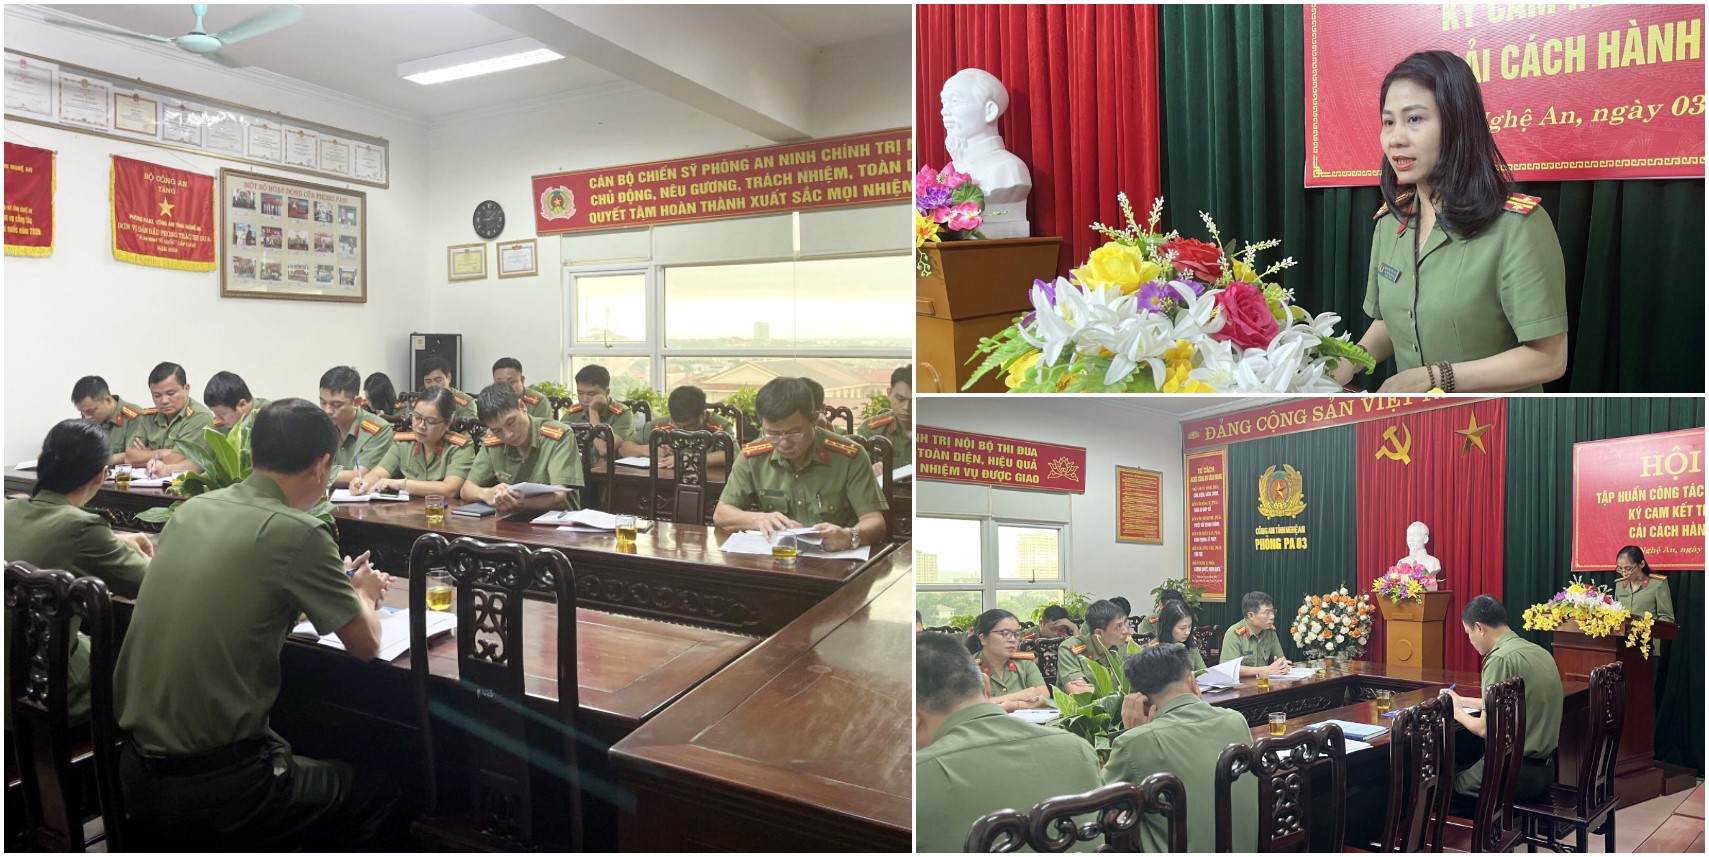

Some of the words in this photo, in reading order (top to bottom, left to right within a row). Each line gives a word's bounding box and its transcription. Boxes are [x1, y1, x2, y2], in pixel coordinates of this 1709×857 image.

[1463, 38, 1490, 83] ẢI
[1501, 34, 1586, 81] CÁCH
[1597, 18, 1702, 70] HÀNH
[1538, 105, 1583, 127] An,
[1591, 99, 1664, 126] ngày
[1671, 94, 1705, 117] 03
[589, 175, 614, 189] CÁN
[617, 171, 634, 187] BỘ
[638, 165, 677, 183] CHIẾN
[680, 163, 698, 179] SỸ
[701, 159, 750, 176] PHÒNG
[753, 155, 775, 170] AN
[779, 150, 817, 167] NINH
[821, 144, 871, 162] CHÍNH
[875, 139, 901, 156] TRỊ
[143, 172, 154, 182] BỘ
[156, 174, 176, 185] CÔNG
[177, 179, 188, 188] AN
[590, 189, 615, 206] CHỦ
[618, 188, 657, 205] ĐỘNG,
[660, 184, 687, 199] NÊU
[690, 179, 742, 196] GƯƠNG,
[745, 172, 793, 189] TRÁCH
[797, 166, 854, 183] NHIỆM,
[857, 159, 902, 177] TOÀN
[589, 206, 626, 224] QUYẾT
[629, 205, 657, 219] TÂM
[660, 200, 697, 217] HOÀN
[700, 197, 746, 213] THÀNH
[750, 189, 787, 208] XUẤT
[792, 185, 822, 204] SẮC
[827, 185, 858, 202] MỌI
[863, 178, 912, 198] NHIỆM
[1204, 417, 1252, 440] ĐẢNG
[1256, 409, 1308, 433] CỘNG
[1312, 397, 1355, 422] SẢN
[932, 434, 951, 448] TRỊ
[954, 437, 975, 449] NỘI
[978, 440, 994, 453] BỘ
[997, 443, 1014, 454] THI
[1017, 446, 1038, 457] ĐUA
[917, 447, 950, 461] TOÀN
[953, 452, 984, 466] DIỆN,
[988, 455, 1013, 469] HIỆU
[1016, 459, 1038, 471] QUẢ
[1640, 444, 1702, 481] HỘI
[920, 463, 960, 477] NHIỆM
[964, 468, 979, 480] VỤ
[981, 470, 1012, 483] ĐƯỢC
[1015, 473, 1040, 484] GIAO
[1596, 490, 1615, 506] TẬP
[1618, 486, 1647, 503] HUẤN
[1649, 486, 1680, 500] CÔNG
[1682, 483, 1704, 498] TÁC
[1628, 506, 1642, 521] KÝ
[1644, 506, 1669, 519] CAM
[1672, 501, 1693, 518] KẾT
[1255, 535, 1282, 550] PHÒNG
[1629, 522, 1647, 539] CẢI
[1649, 522, 1679, 538] CÁCH
